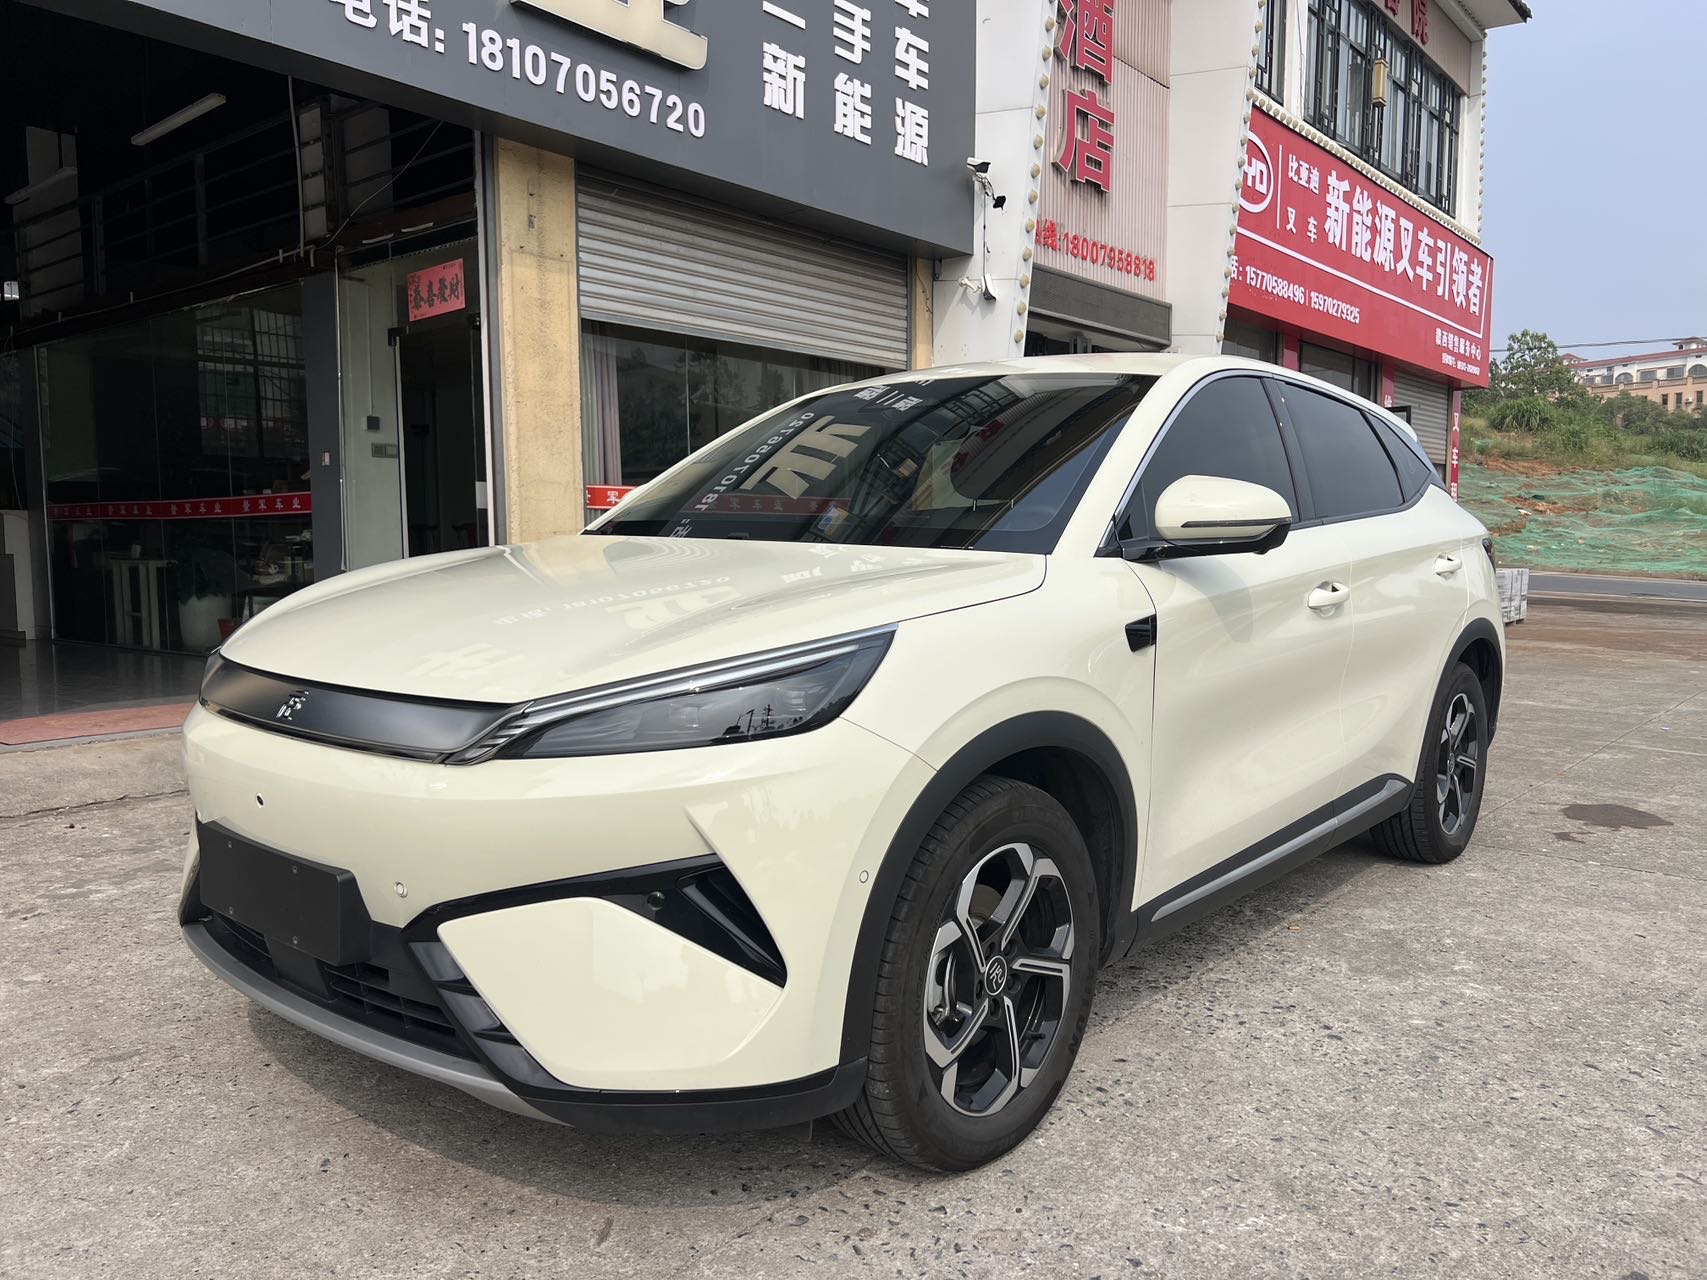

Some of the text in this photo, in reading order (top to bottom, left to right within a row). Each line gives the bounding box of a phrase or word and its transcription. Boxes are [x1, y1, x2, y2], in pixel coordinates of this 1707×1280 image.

[762, 42, 930, 167] 新能源
[1057, 0, 1115, 193] 酒店
[1285, 206, 1318, 243] 叉车
[1287, 153, 1321, 195] 比亚迪
[1323, 169, 1483, 316] 新能源叉车引领者
